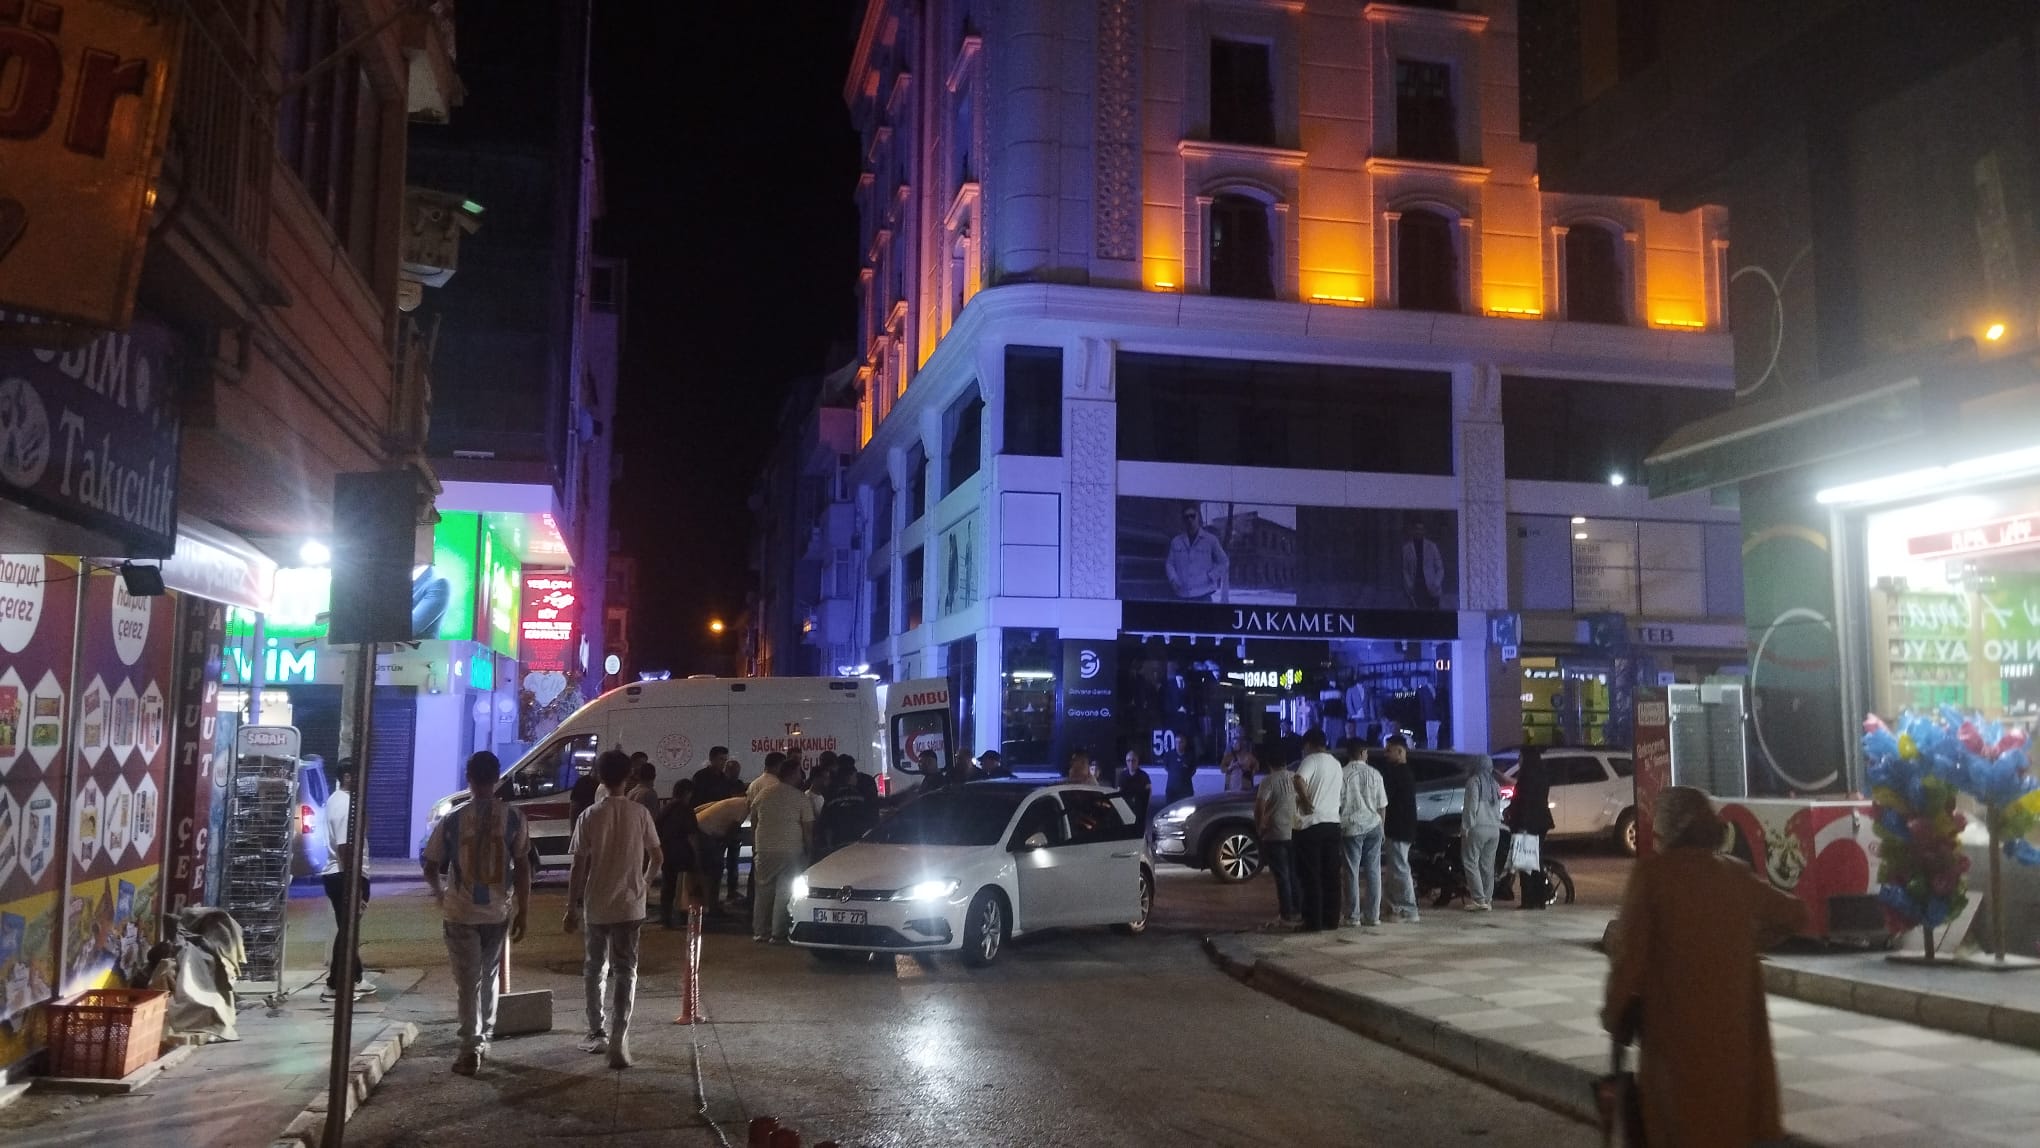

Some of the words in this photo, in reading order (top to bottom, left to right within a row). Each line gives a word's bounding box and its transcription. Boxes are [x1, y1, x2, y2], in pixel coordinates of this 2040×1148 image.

[1231, 609, 1356, 634] JAKAMEN
[1636, 627, 1675, 643] TEB
[902, 690, 948, 707] AMBU
[1067, 708, 1099, 718] Giovane
[751, 737, 785, 752] SAĞLIK
[788, 736, 836, 750] BAKANLIĞI
